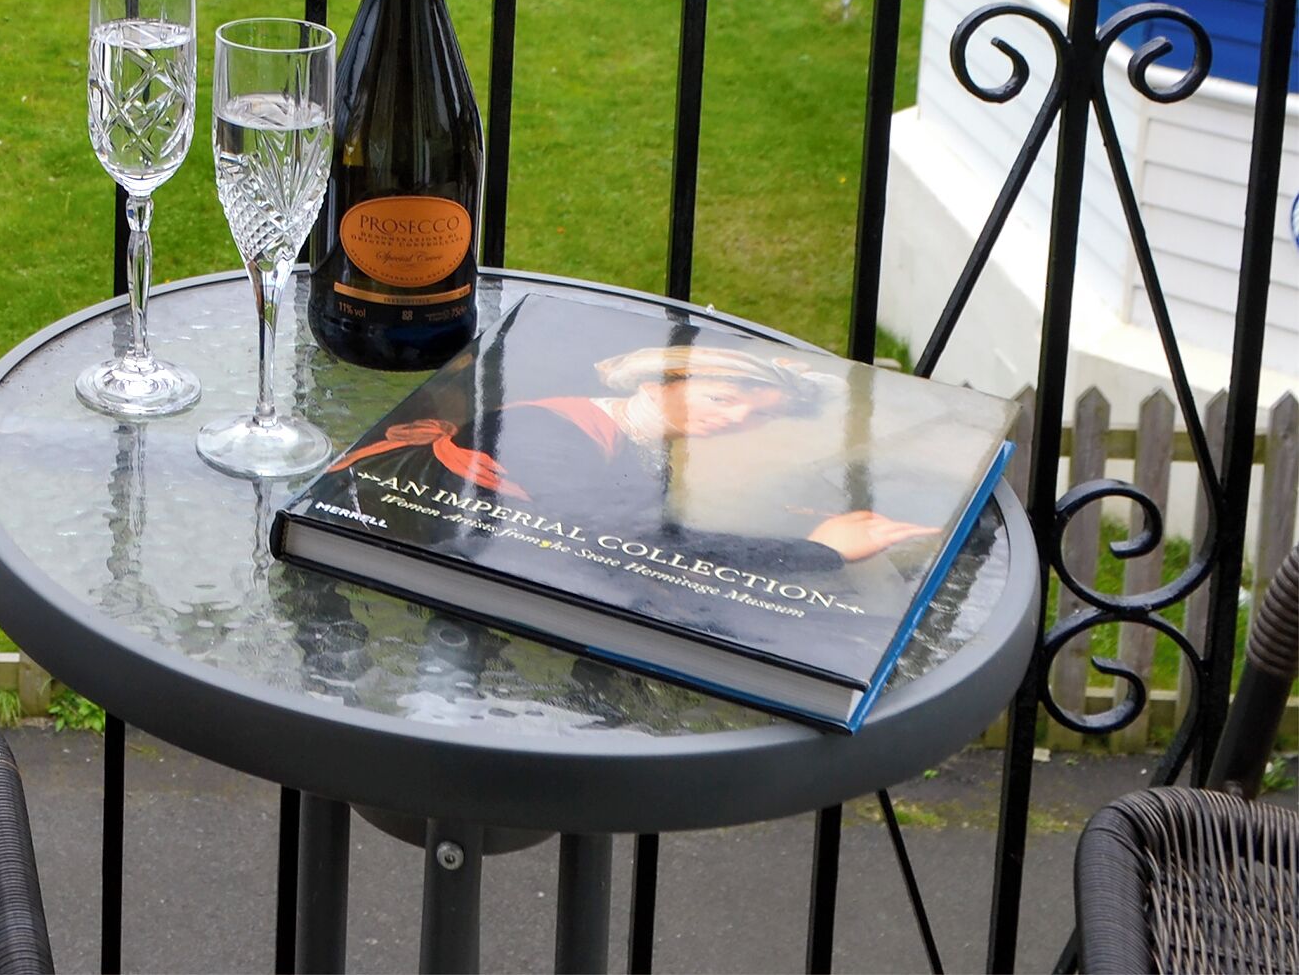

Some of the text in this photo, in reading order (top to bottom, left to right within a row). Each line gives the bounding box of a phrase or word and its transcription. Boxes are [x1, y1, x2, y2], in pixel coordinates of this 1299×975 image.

[360, 214, 460, 235] PROSECCO
[315, 500, 389, 529] MERRELL
[378, 476, 838, 608] AN IMPERIAL COLLECTION
[381, 493, 441, 518] Women
[442, 511, 498, 537] Artists
[494, 528, 540, 545] from
[574, 547, 622, 567] State
[624, 561, 721, 596] Hermitage
[723, 588, 805, 618] Museum
